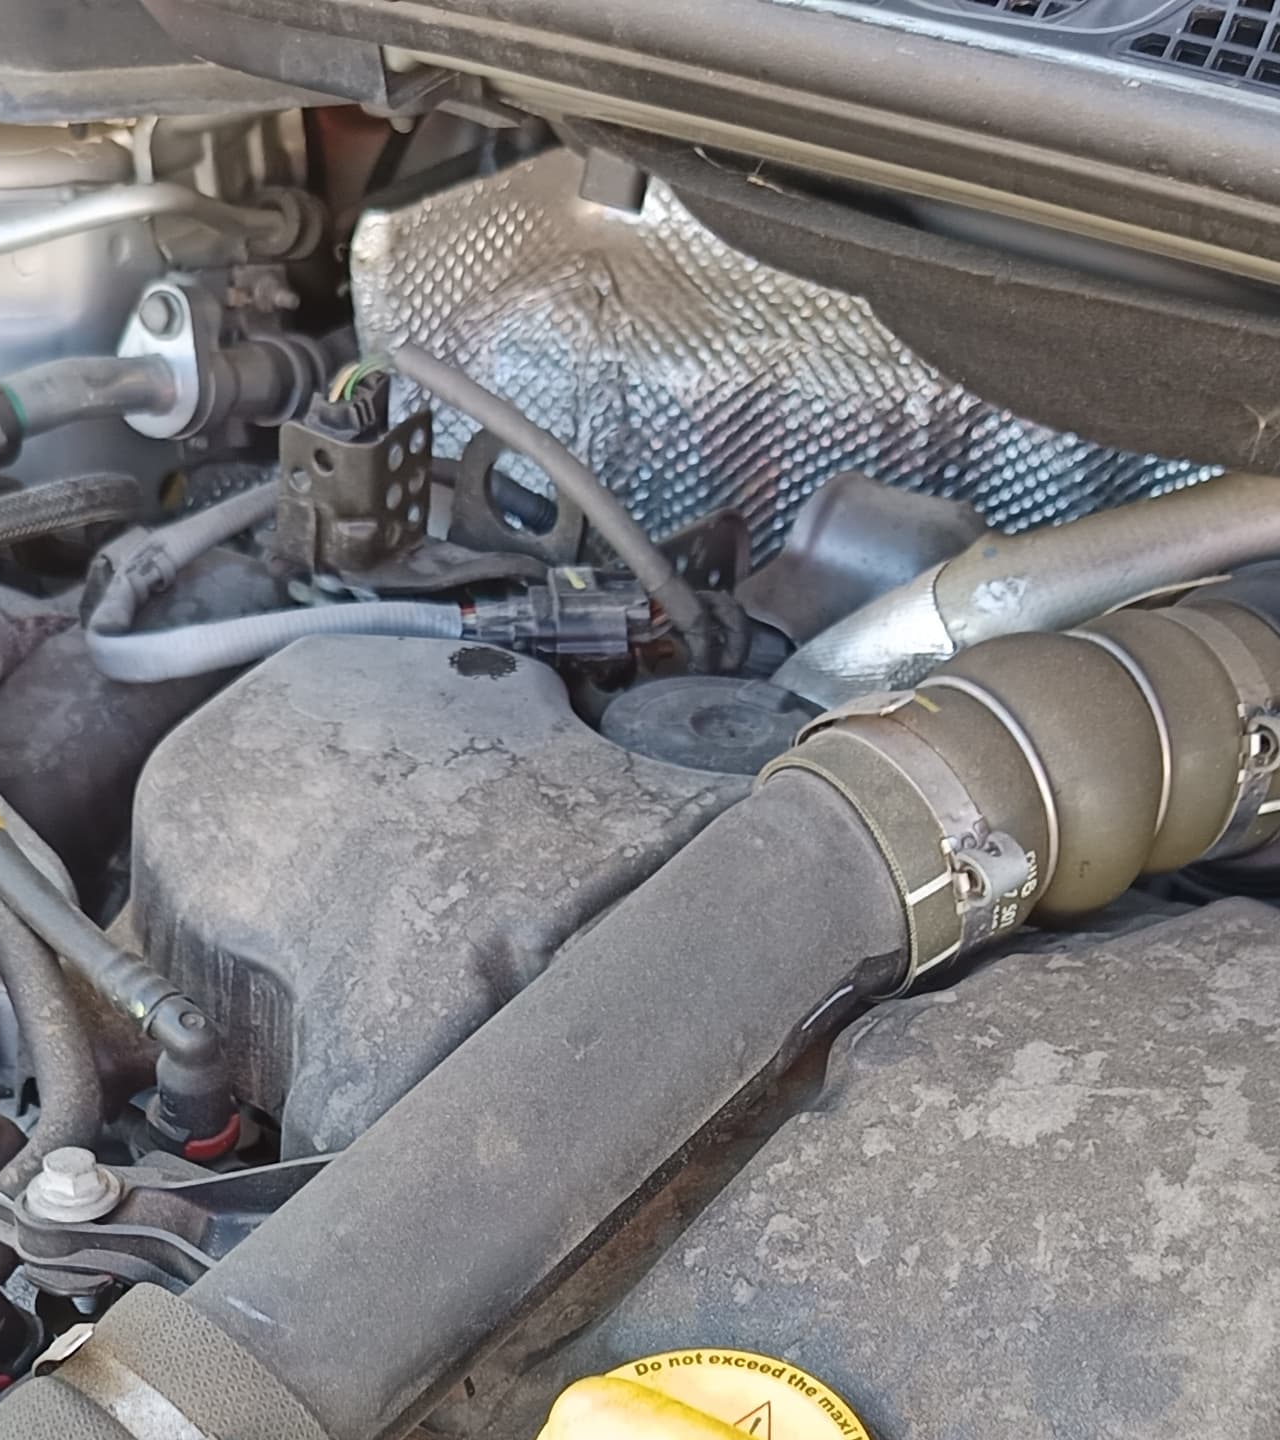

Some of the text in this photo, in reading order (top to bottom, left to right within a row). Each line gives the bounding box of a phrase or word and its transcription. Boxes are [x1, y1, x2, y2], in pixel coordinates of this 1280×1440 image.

[634, 1361, 662, 1376] Do
[669, 1352, 703, 1368] not
[708, 1355, 787, 1380] exceed
[786, 1373, 818, 1398] the
[817, 1395, 859, 1436] maxi
